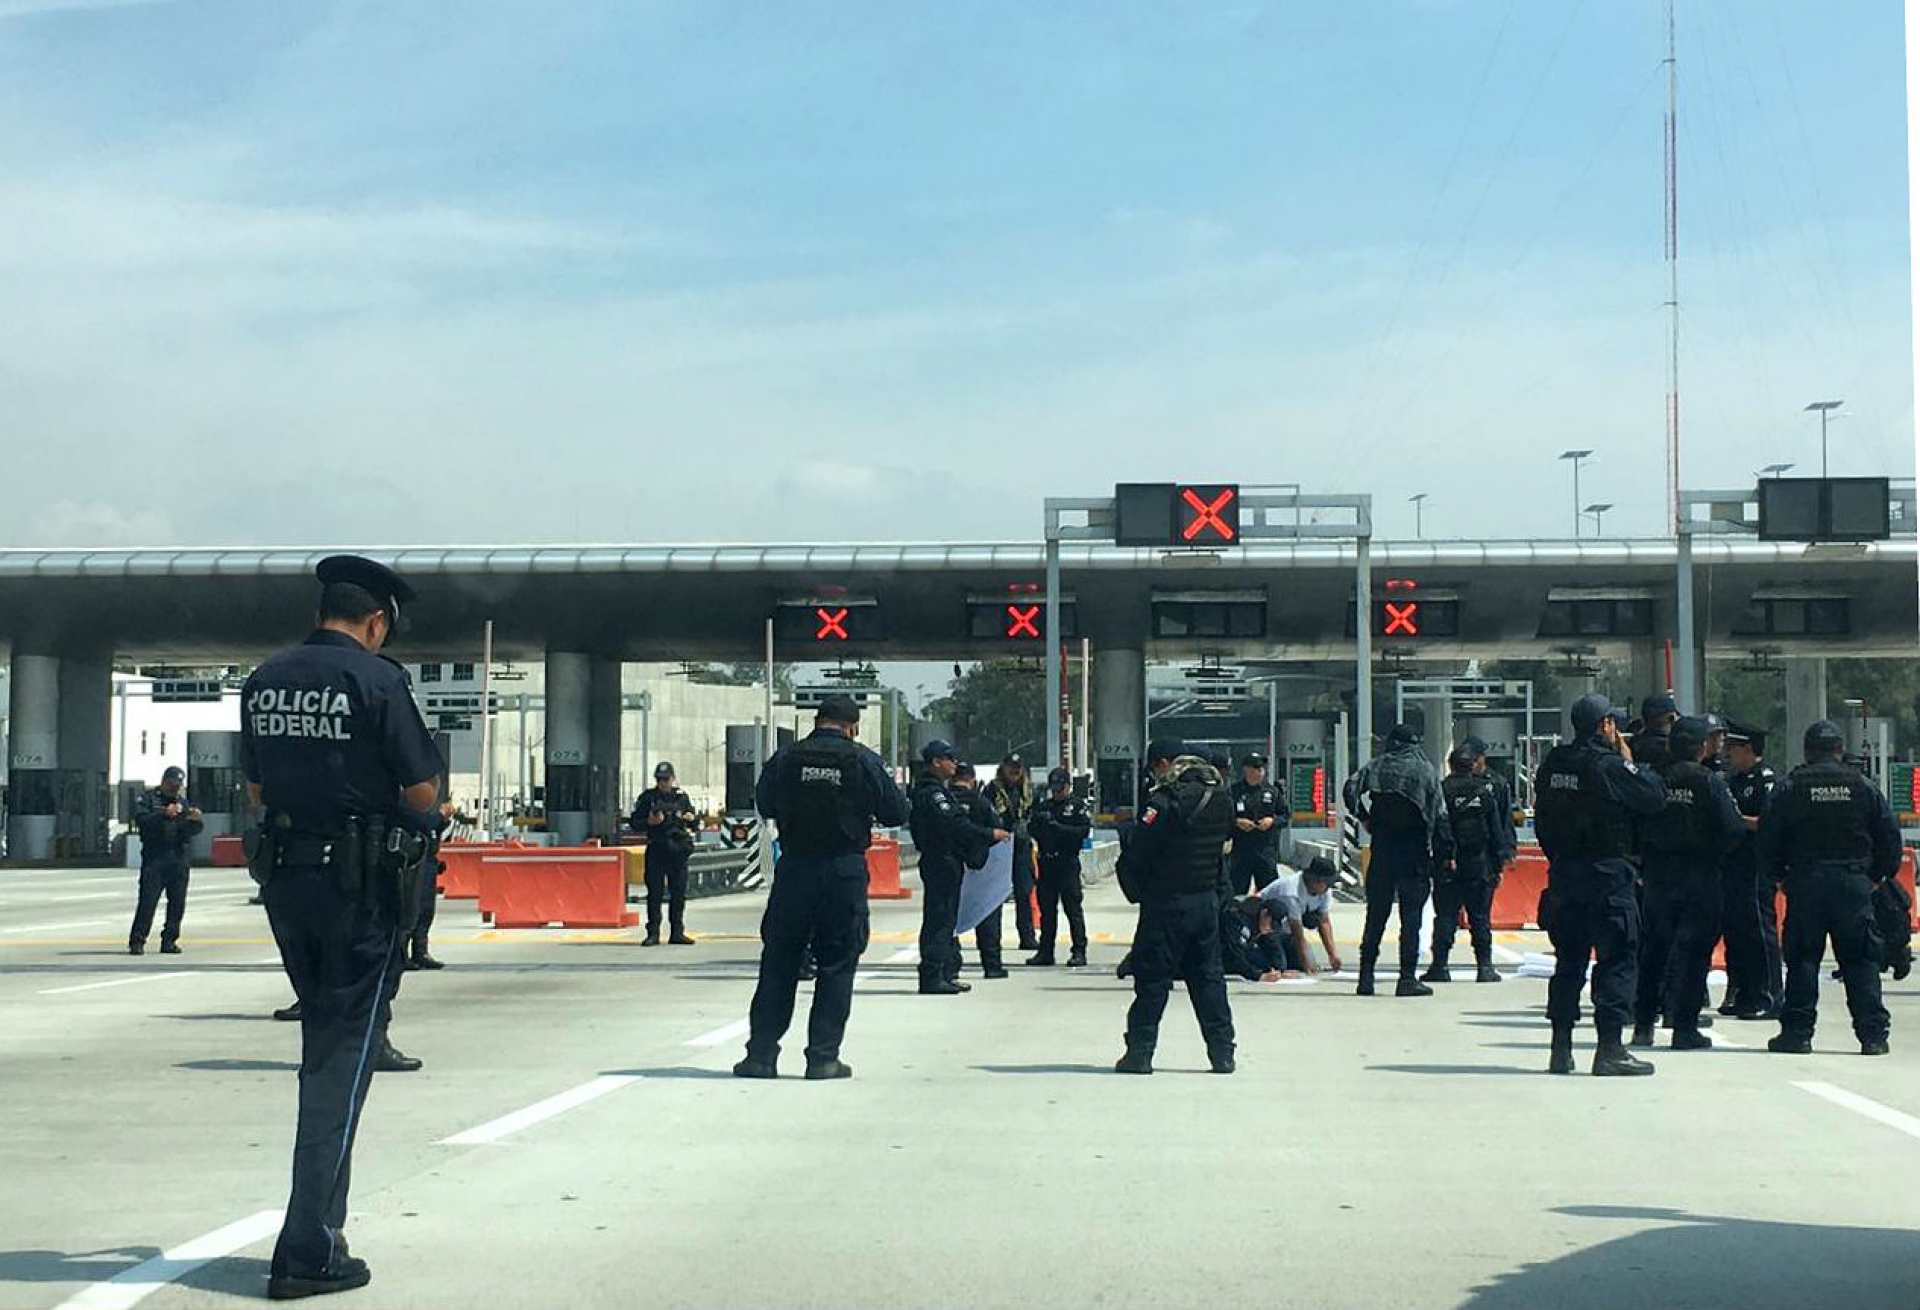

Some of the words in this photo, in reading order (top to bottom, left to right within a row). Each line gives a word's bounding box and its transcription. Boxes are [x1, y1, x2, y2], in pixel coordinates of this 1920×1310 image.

[1104, 744, 1130, 754] 074
[1289, 743, 1314, 753] 074
[553, 750, 580, 760] 074
